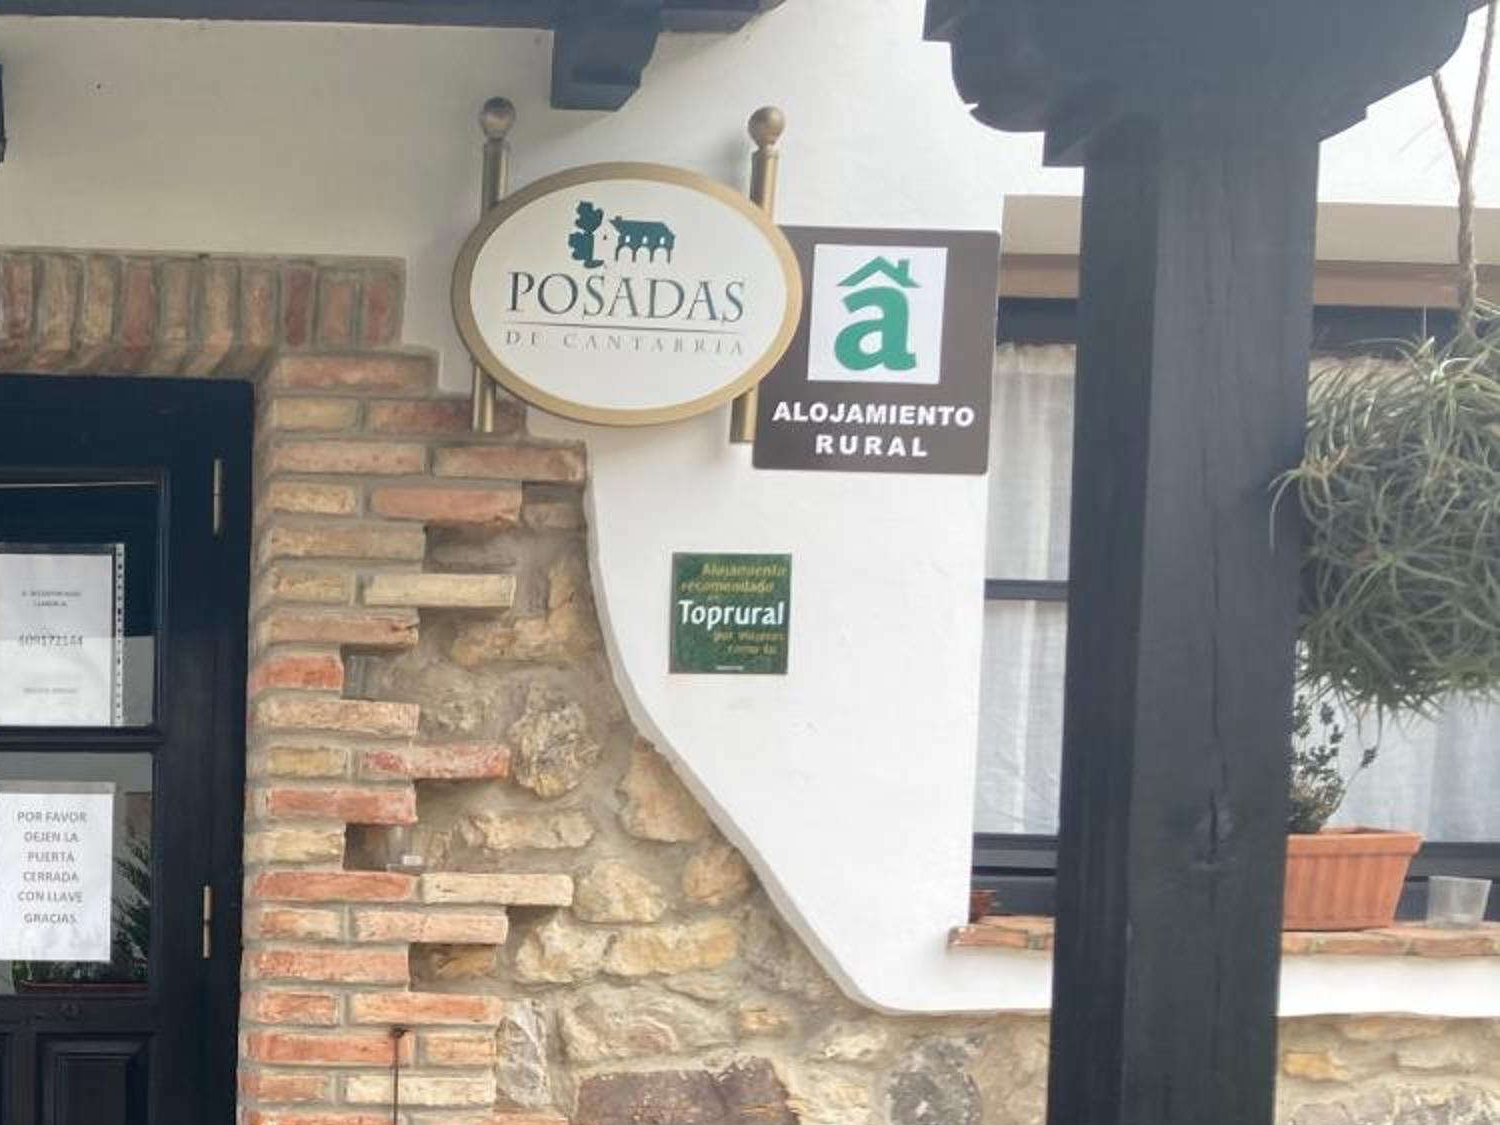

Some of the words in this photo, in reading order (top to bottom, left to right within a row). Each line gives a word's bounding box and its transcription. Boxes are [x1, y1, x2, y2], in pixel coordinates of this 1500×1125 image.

[505, 270, 746, 323] POSADAS
[504, 329, 542, 347] DE
[562, 332, 745, 356] CANTABRIA
[771, 401, 975, 428] ALOJAMIENTO
[814, 434, 929, 458] RURAL
[677, 599, 786, 631] Toprural
[17, 811, 42, 823] POR
[45, 811, 88, 823] FAVOR
[23, 831, 61, 843] DEJEN
[64, 831, 80, 843] LA
[27, 851, 76, 863] PUERTA
[22, 871, 80, 883] CERRADA
[17, 891, 44, 903] CON
[47, 891, 84, 903] LLAVE
[23, 913, 78, 925] GRACIAS
